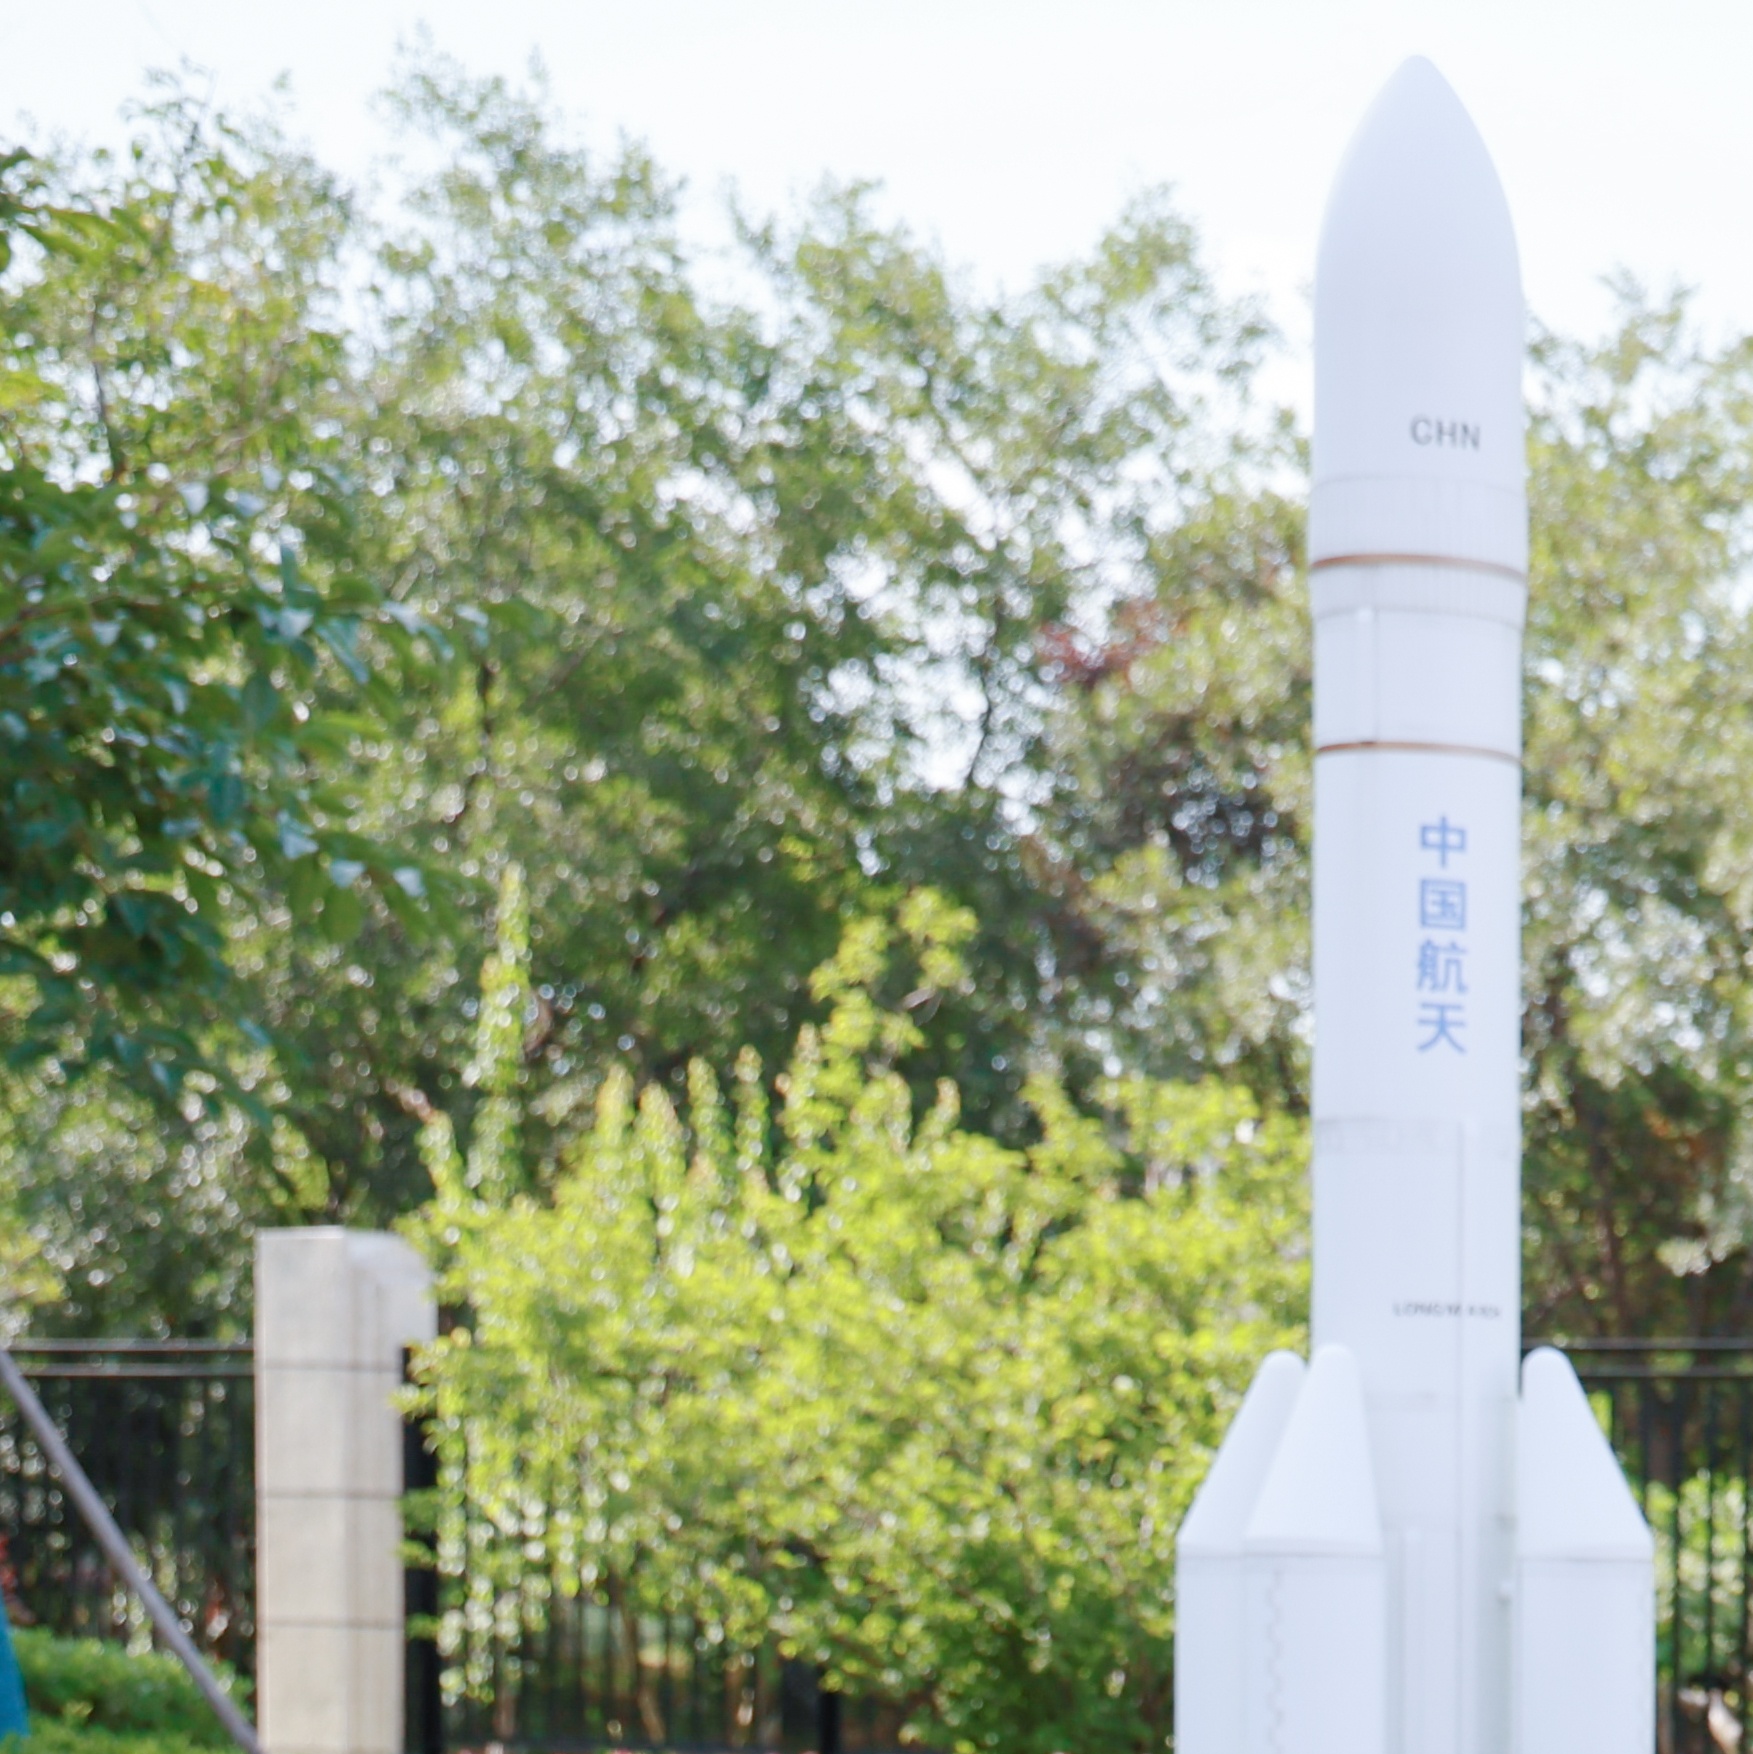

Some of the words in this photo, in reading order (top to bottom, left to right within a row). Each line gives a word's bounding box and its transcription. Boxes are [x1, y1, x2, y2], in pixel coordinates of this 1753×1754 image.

[1409, 413, 1480, 451] CHN
[1417, 815, 1468, 1054] 中国航天
